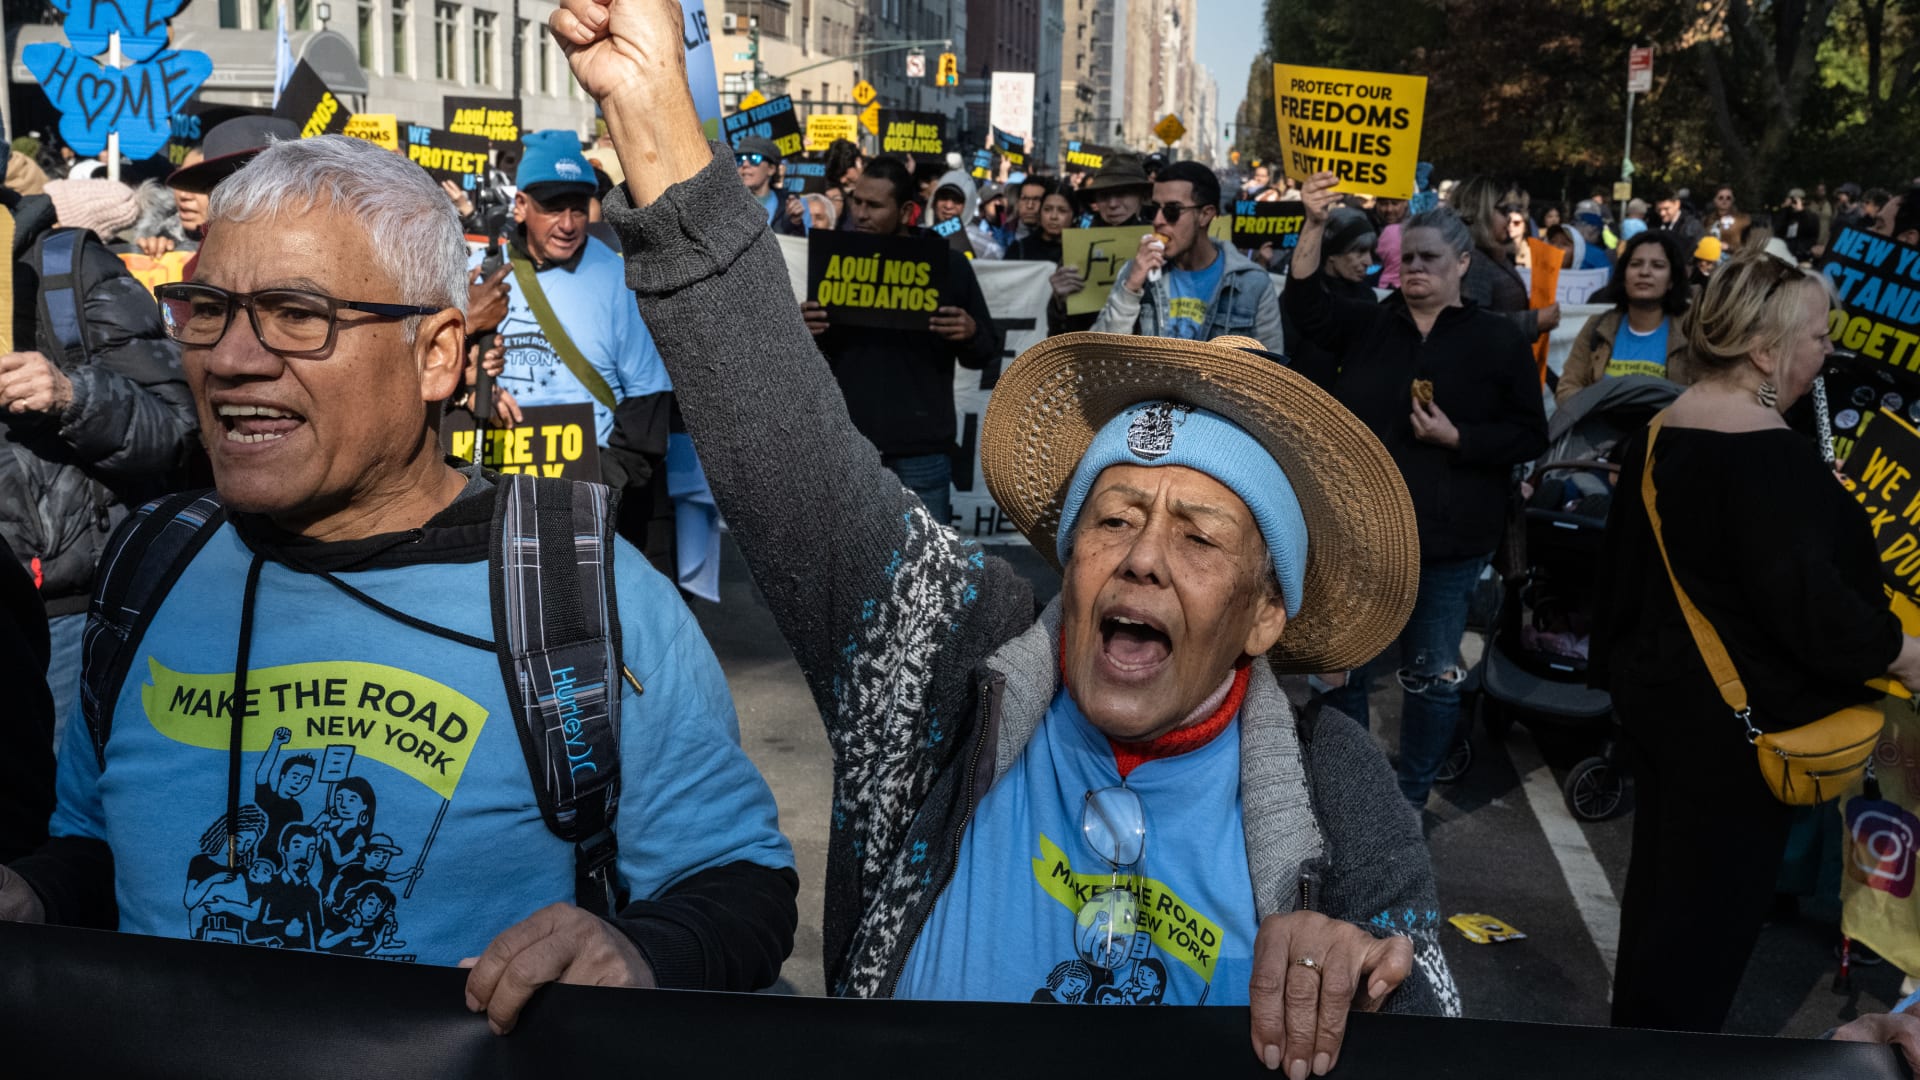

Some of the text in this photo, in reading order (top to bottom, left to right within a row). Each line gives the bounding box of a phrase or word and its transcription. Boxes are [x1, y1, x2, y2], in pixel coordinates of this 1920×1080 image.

[1291, 78, 1392, 100] PROTECT OUR
[454, 107, 514, 126] AQUÍ NOS
[725, 111, 749, 132] NEW
[1281, 95, 1410, 130] FREEDOMS
[409, 126, 432, 145] WE
[883, 135, 942, 154] QUEDAMOS
[887, 120, 938, 139] AQUÍ NOS
[1289, 123, 1392, 157] FAMILIES
[410, 145, 488, 174] PROTECT
[1067, 150, 1103, 169] PROTEC
[1292, 151, 1388, 185] FUTURES
[463, 174, 477, 190] U
[1236, 200, 1257, 216] WE
[1234, 216, 1305, 234] PROTECT
[1832, 227, 1896, 268] NEW
[825, 253, 931, 286] AQUÍ NOS
[817, 279, 939, 312] QUEDAMOS
[510, 351, 553, 366] TION
[542, 424, 583, 461] TO
[1861, 447, 1911, 501] WE
[169, 678, 467, 743] MAKE THE ROAD
[551, 666, 585, 746] Hurley
[306, 716, 456, 775] NEW YORK
[1156, 893, 1216, 947] ROAD
[1124, 908, 1212, 968] NEW YORK
